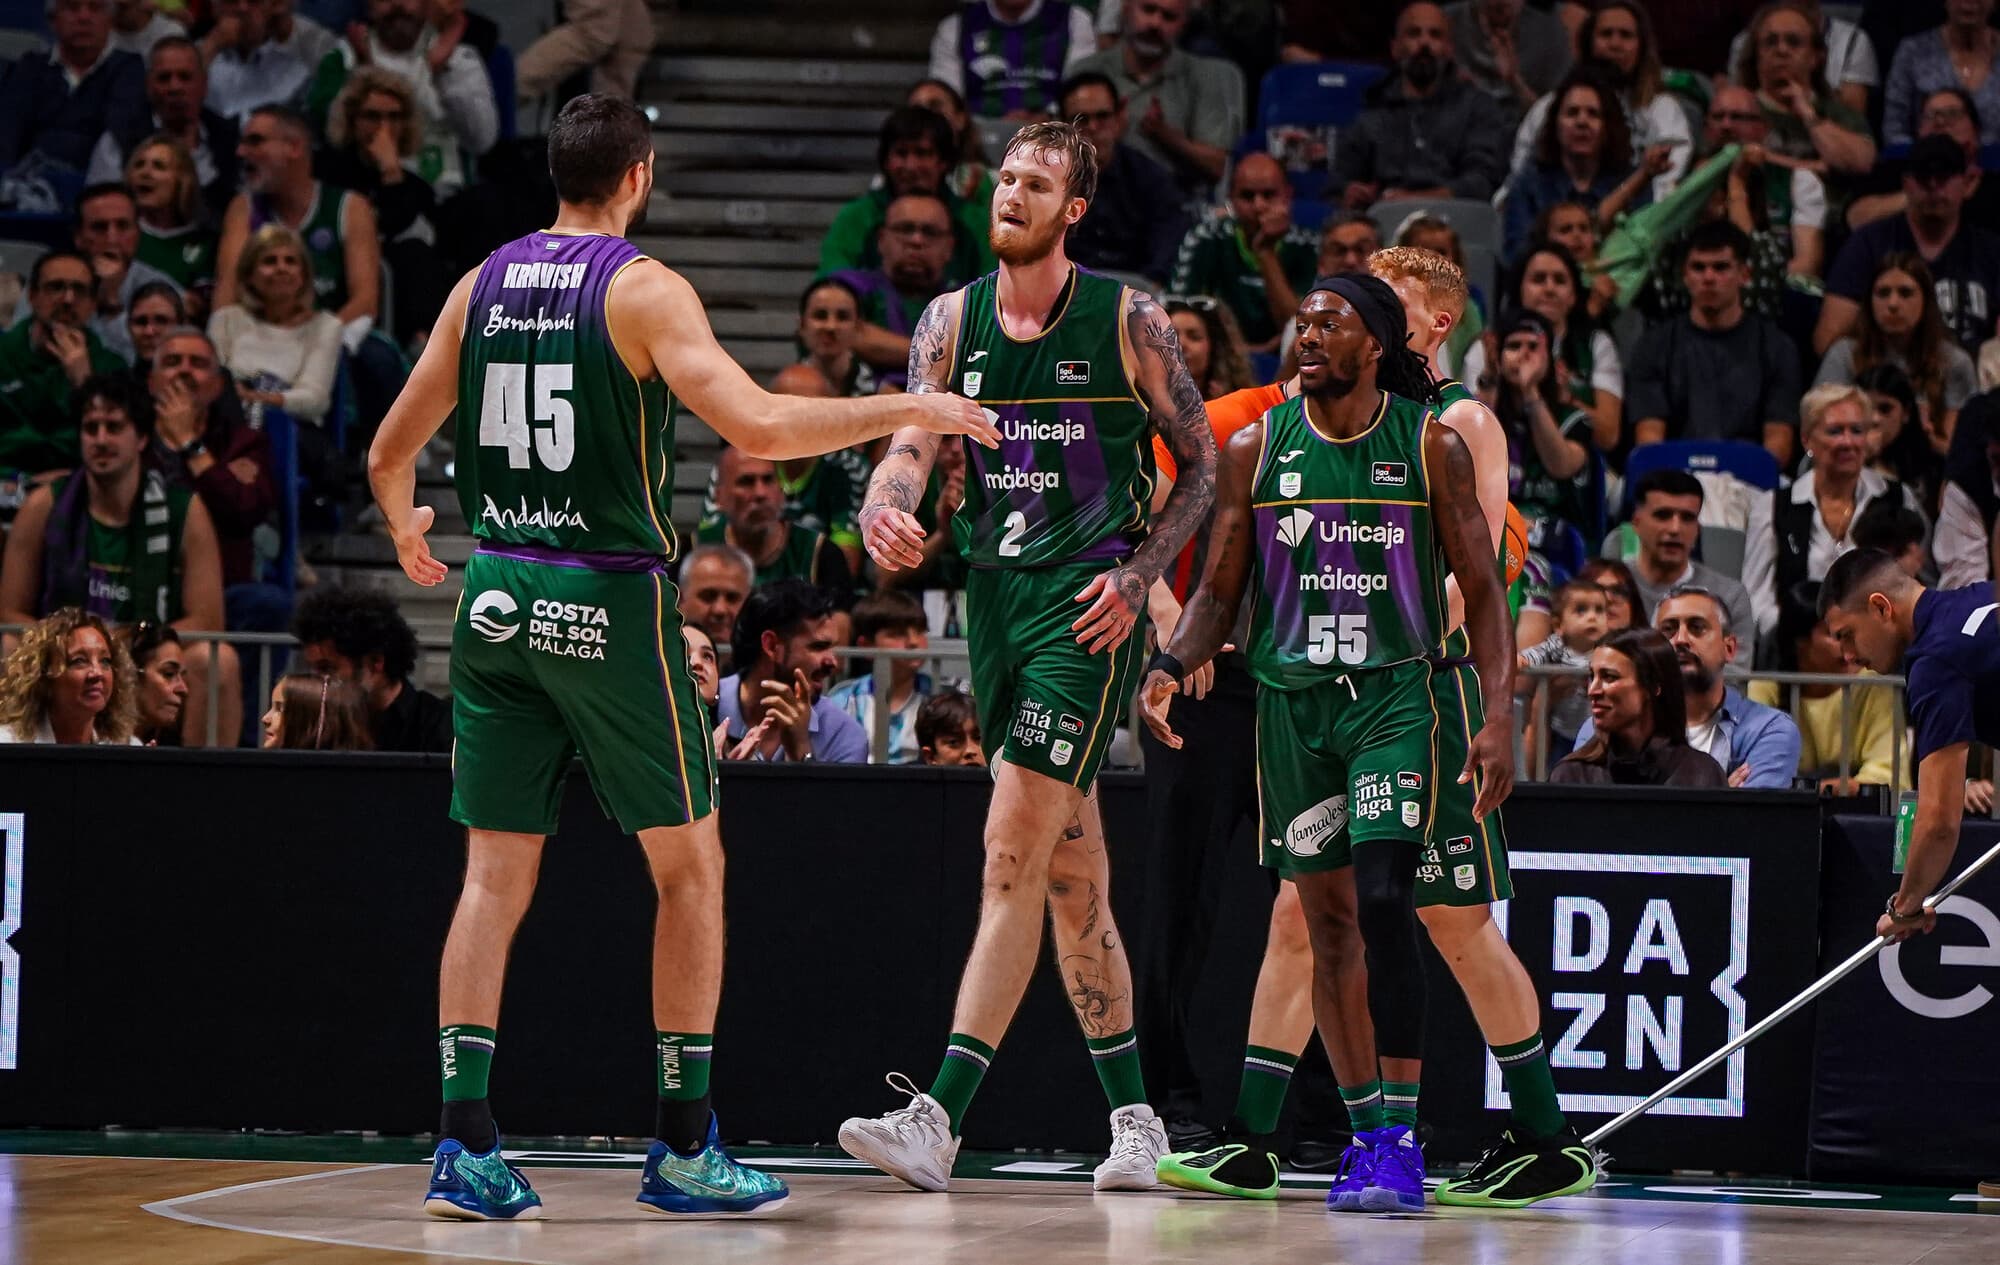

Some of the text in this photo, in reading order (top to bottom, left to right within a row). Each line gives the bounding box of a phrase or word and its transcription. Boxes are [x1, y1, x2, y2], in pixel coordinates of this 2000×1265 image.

[502, 262, 588, 290] KRAVISH
[479, 363, 575, 472] 45
[1004, 419, 1085, 446] Unicaja
[999, 510, 1026, 557] 2
[1319, 520, 1405, 549] Unicaja
[532, 599, 610, 626] COSTA
[529, 619, 608, 644] DEL SOL
[1307, 614, 1368, 665] 55
[529, 636, 605, 661] MÁLAGA
[1012, 718, 1047, 747] laga
[1061, 720, 1078, 732] acb
[1355, 772, 1379, 788] sabor
[1400, 778, 1417, 787] acb
[1356, 797, 1394, 820] laga
[1449, 843, 1467, 852] acb
[1552, 896, 1690, 975] DA
[1550, 992, 1683, 1071] ZN
[442, 1037, 457, 1080] UNICAJA
[662, 1045, 681, 1089] UNICAJA
